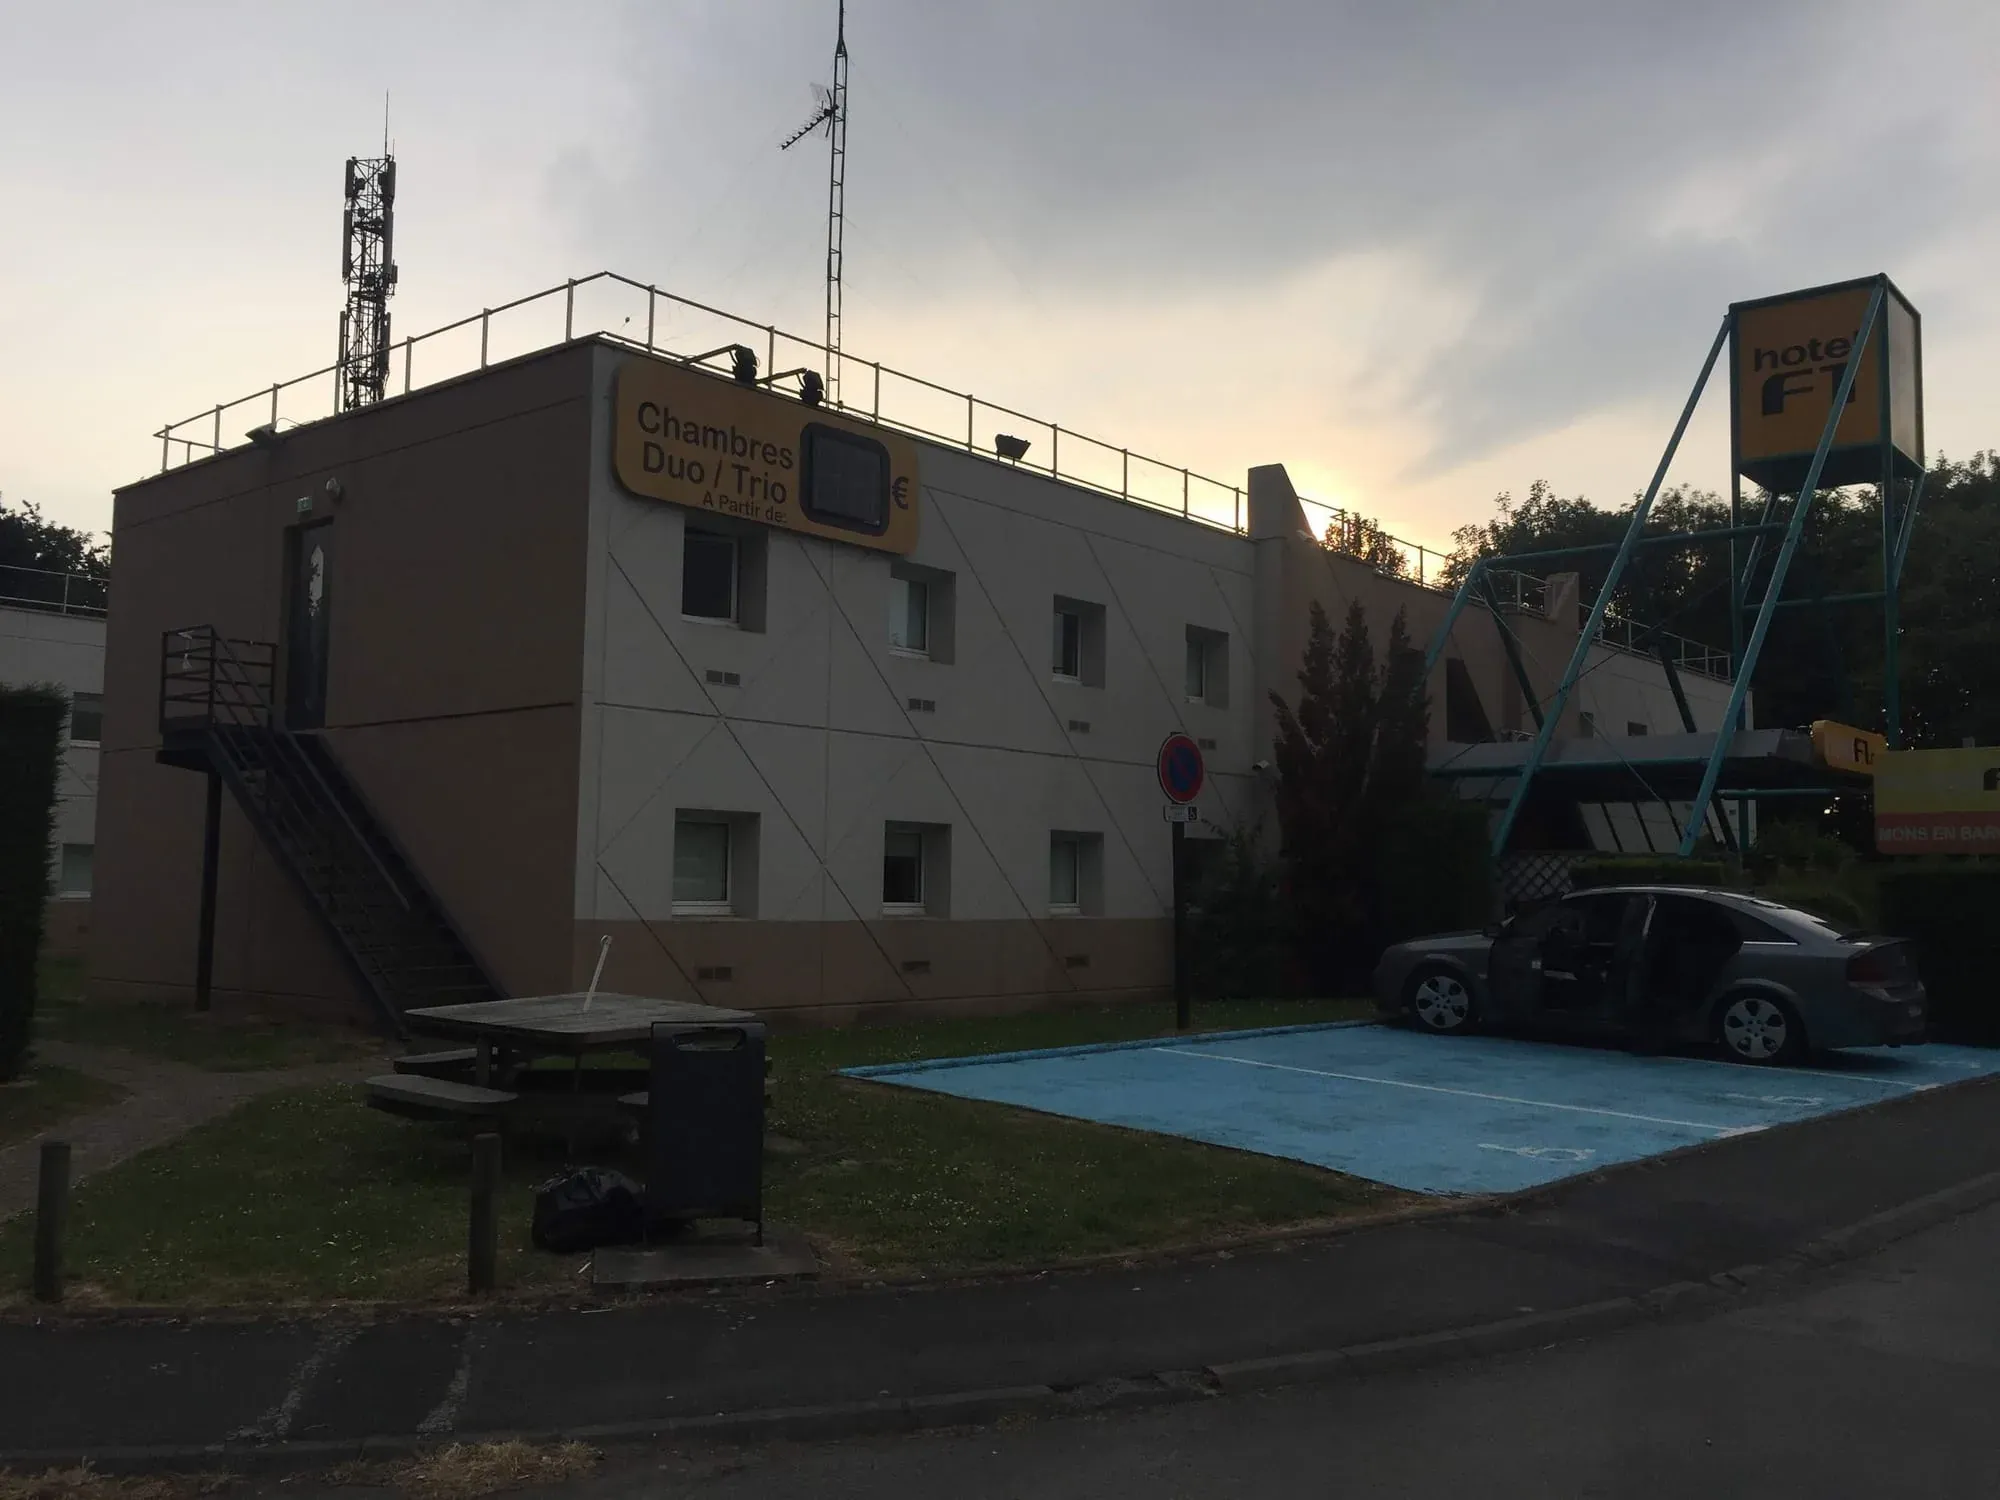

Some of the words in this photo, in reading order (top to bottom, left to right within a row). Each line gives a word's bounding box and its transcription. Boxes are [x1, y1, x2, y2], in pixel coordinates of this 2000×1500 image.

[1753, 328, 1860, 372] hote
[1761, 362, 1857, 416] F1
[637, 401, 794, 471] Chambres
[643, 441, 705, 486] Duo
[731, 464, 787, 504] Trio
[891, 476, 910, 510] €
[702, 490, 714, 507] A
[719, 494, 761, 520] Partir
[1878, 825, 1929, 841] MONS
[1932, 825, 1956, 841] EN
